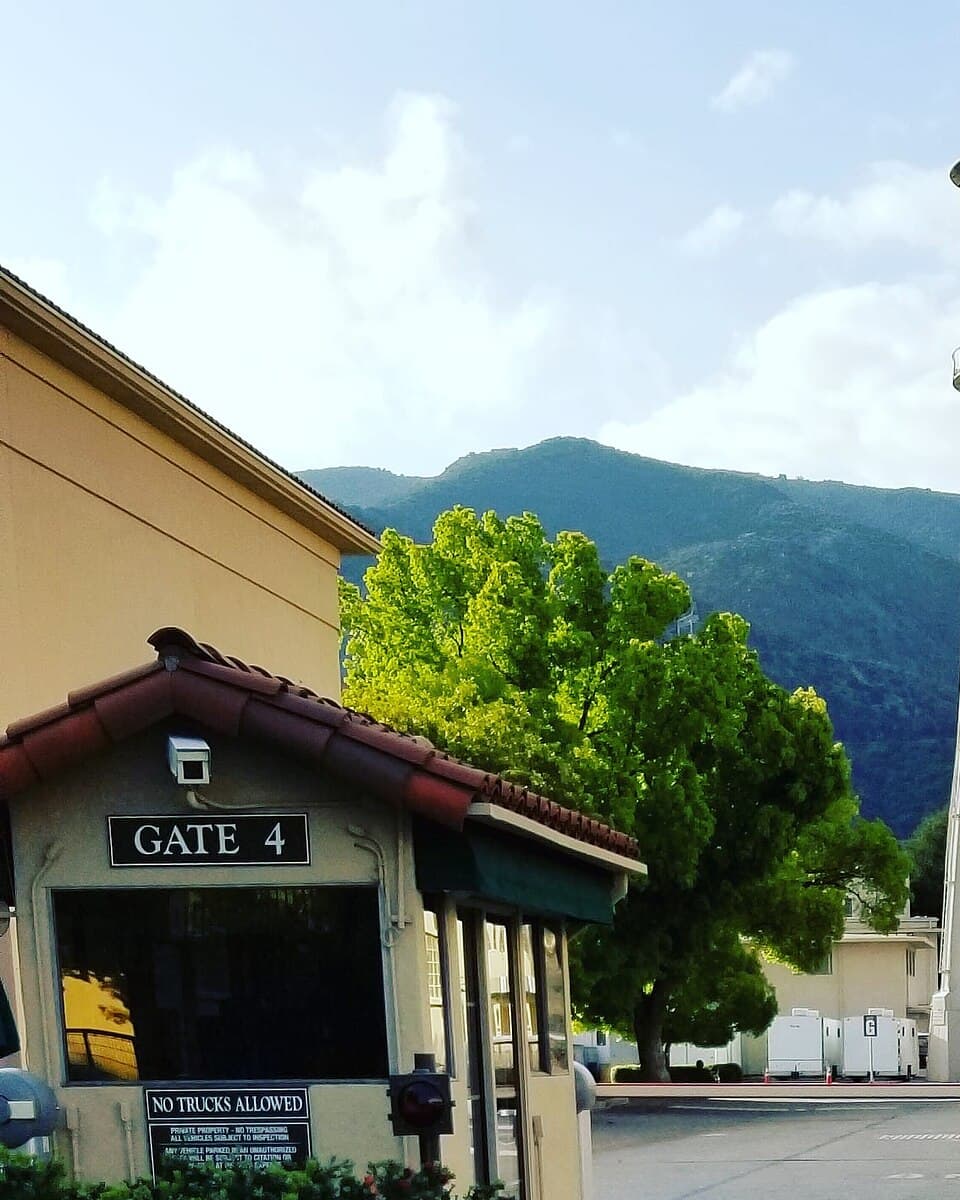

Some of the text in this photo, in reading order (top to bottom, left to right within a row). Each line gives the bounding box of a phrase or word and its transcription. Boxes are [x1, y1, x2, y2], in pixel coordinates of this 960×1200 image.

[134, 822, 286, 856] GATE 4
[151, 1095, 303, 1113] NO TRUCKS ALLOWED
[170, 1127, 196, 1135] PRIVATE
[245, 1126, 288, 1134] TRESPASSING
[170, 1134, 182, 1142] ALL
